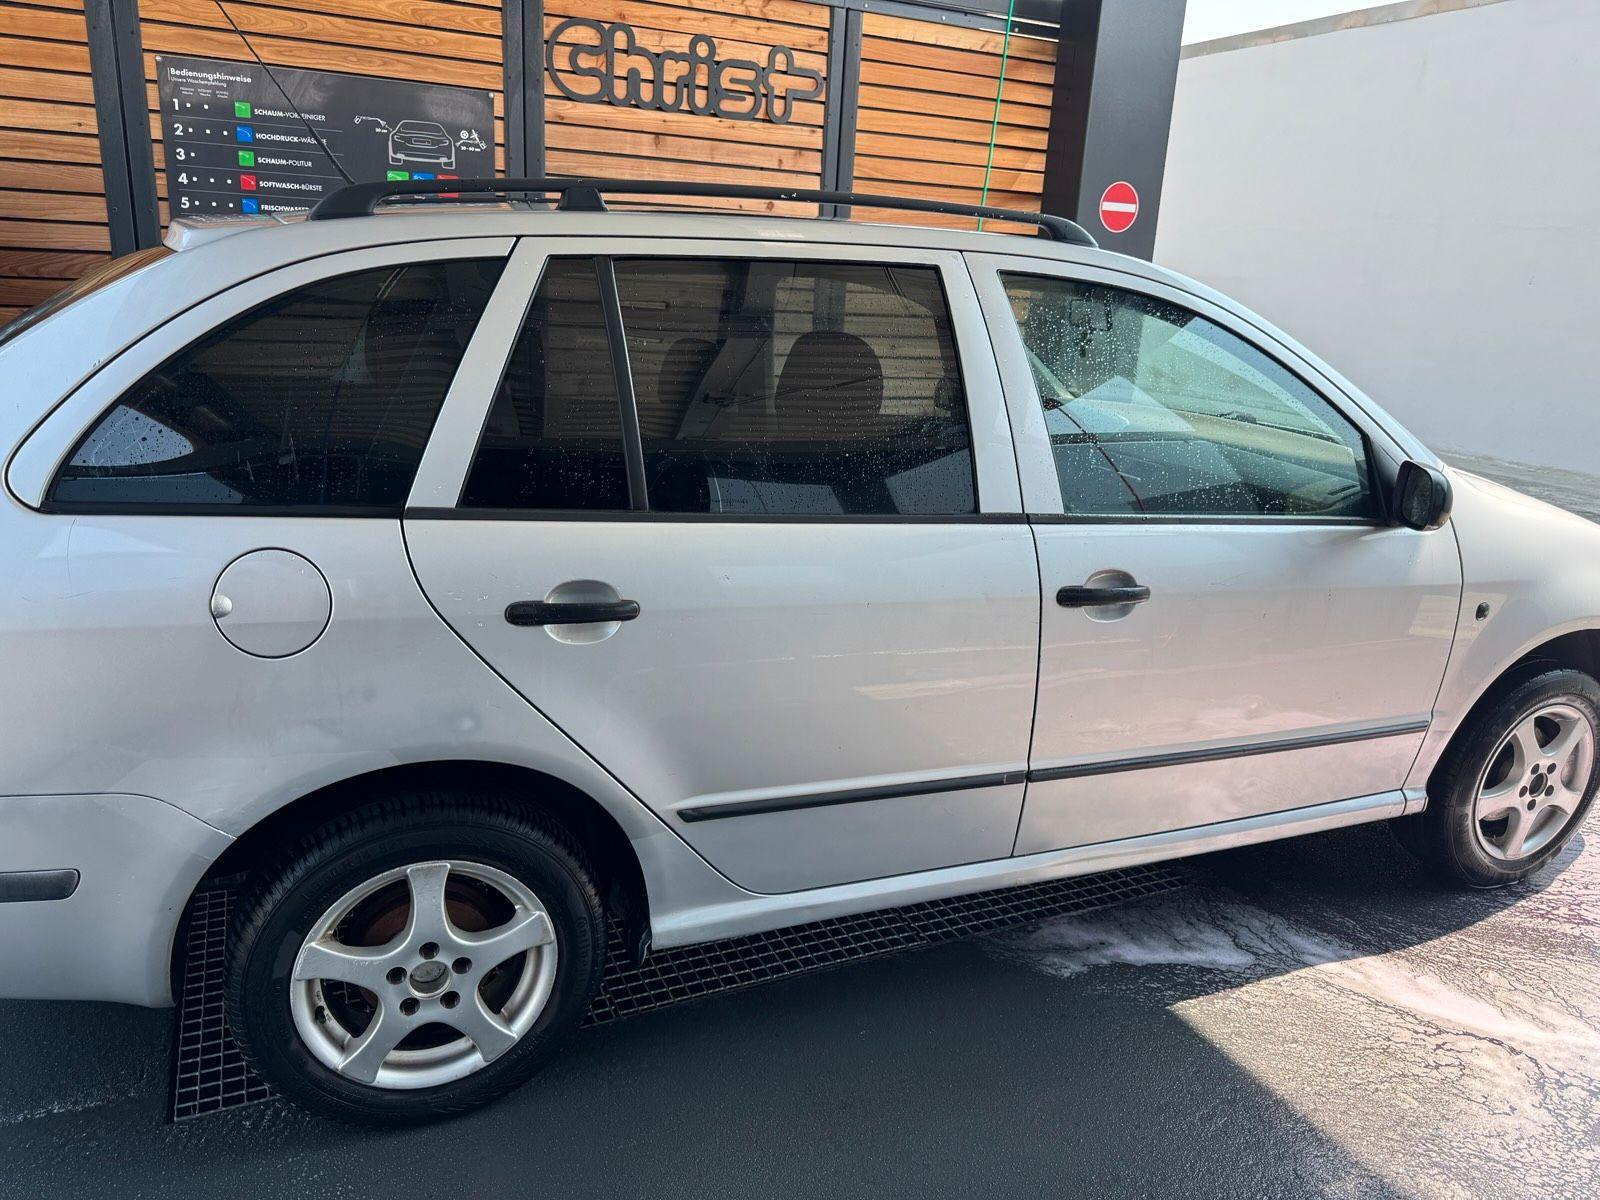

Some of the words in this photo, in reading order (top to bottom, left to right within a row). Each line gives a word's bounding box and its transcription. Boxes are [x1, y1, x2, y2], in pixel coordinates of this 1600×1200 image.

[170, 67, 252, 83] Bedienungshinweise
[545, 17, 824, 124] Christ
[172, 98, 180, 110] 1
[254, 108, 326, 121] SCHAUM-VOREINIGER
[173, 123, 184, 136] 2
[256, 133, 328, 146] HOCHDRUCK-WÄSE
[175, 148, 186, 160] 3
[257, 156, 313, 168] SCHAUM-POLITUR
[178, 173, 189, 185] 4
[259, 180, 323, 192] SOFTWASCH-BÜRSTE
[180, 197, 190, 209] 5
